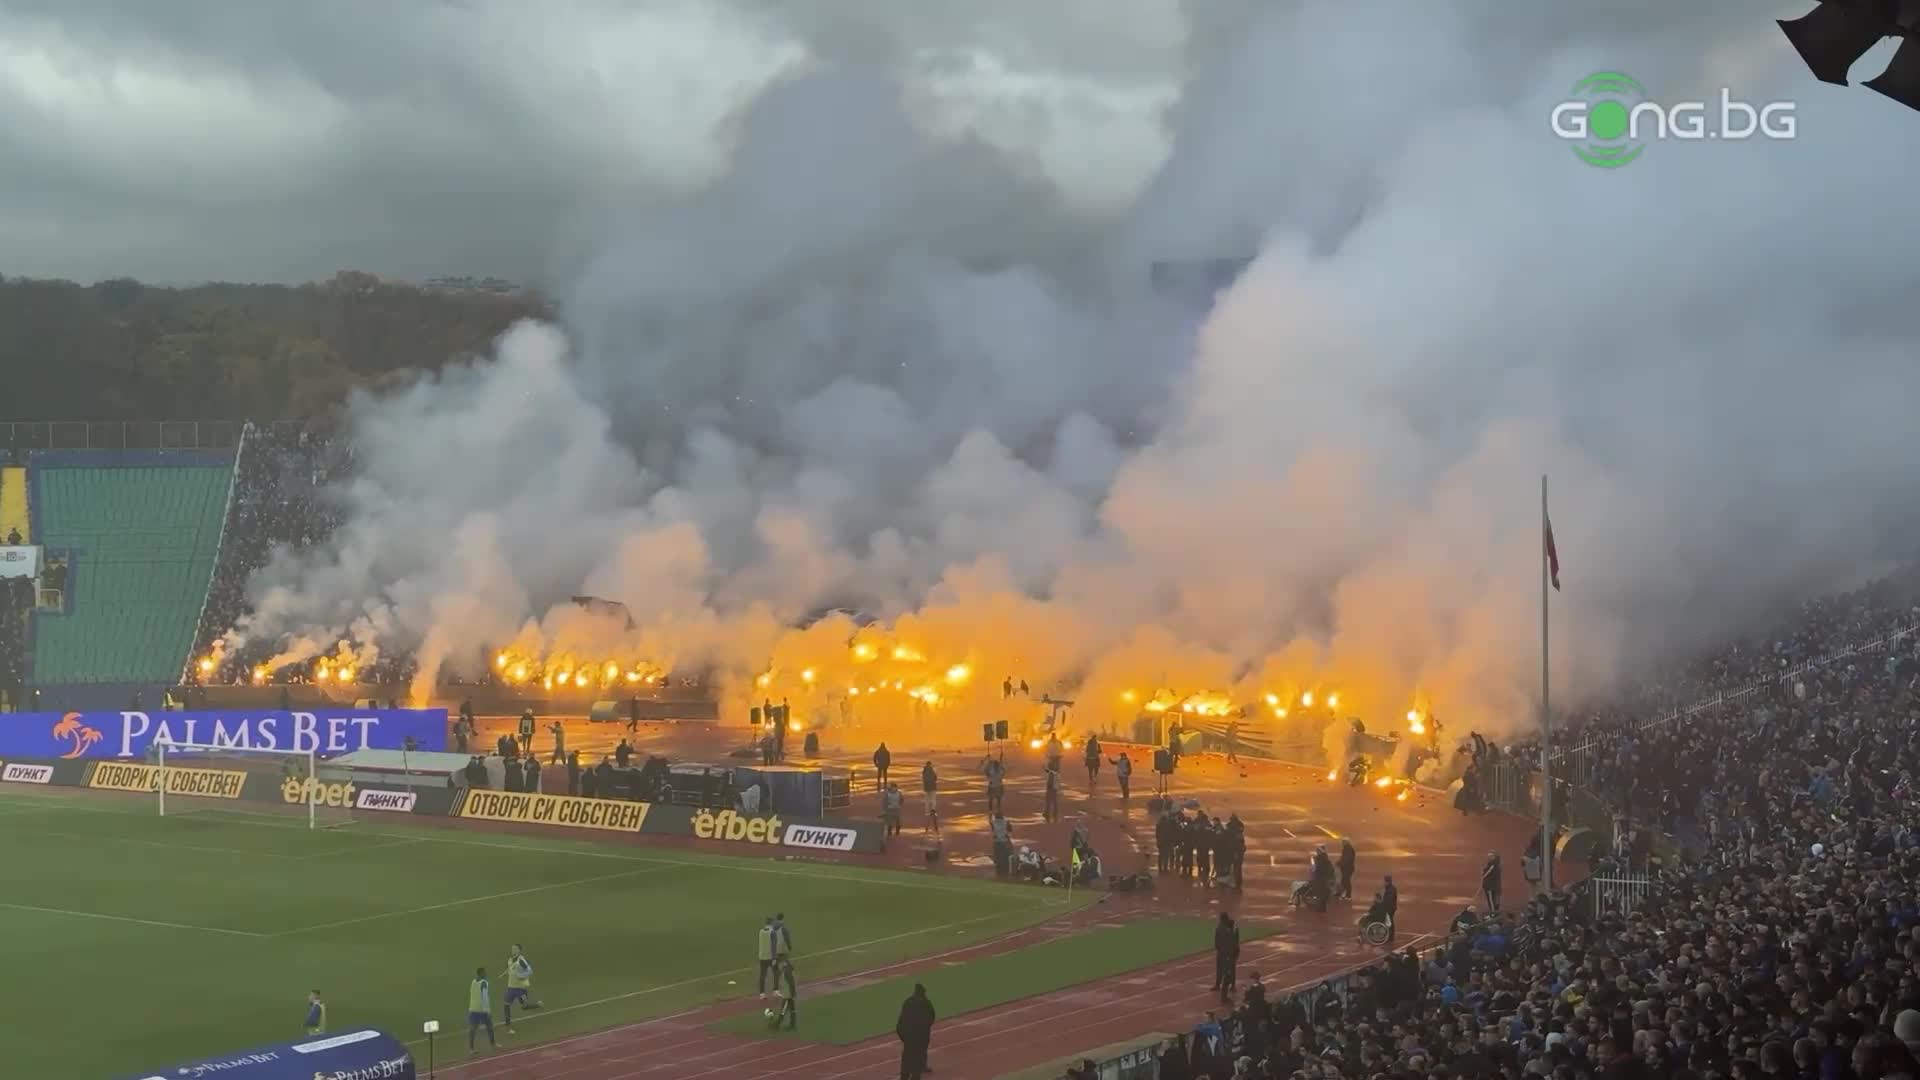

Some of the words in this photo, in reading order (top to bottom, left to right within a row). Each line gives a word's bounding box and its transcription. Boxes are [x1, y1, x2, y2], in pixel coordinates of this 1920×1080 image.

[8, 767, 48, 780] ПУНКТ
[96, 762, 150, 788] ОТВОРИ
[171, 770, 242, 797] СОБСТВЕН
[469, 792, 531, 818] ОТВОРИ
[533, 797, 556, 821] СИ
[558, 799, 642, 829] СОБСТВЕН
[694, 809, 783, 844] efbet
[791, 829, 848, 847] ПУНКТ
